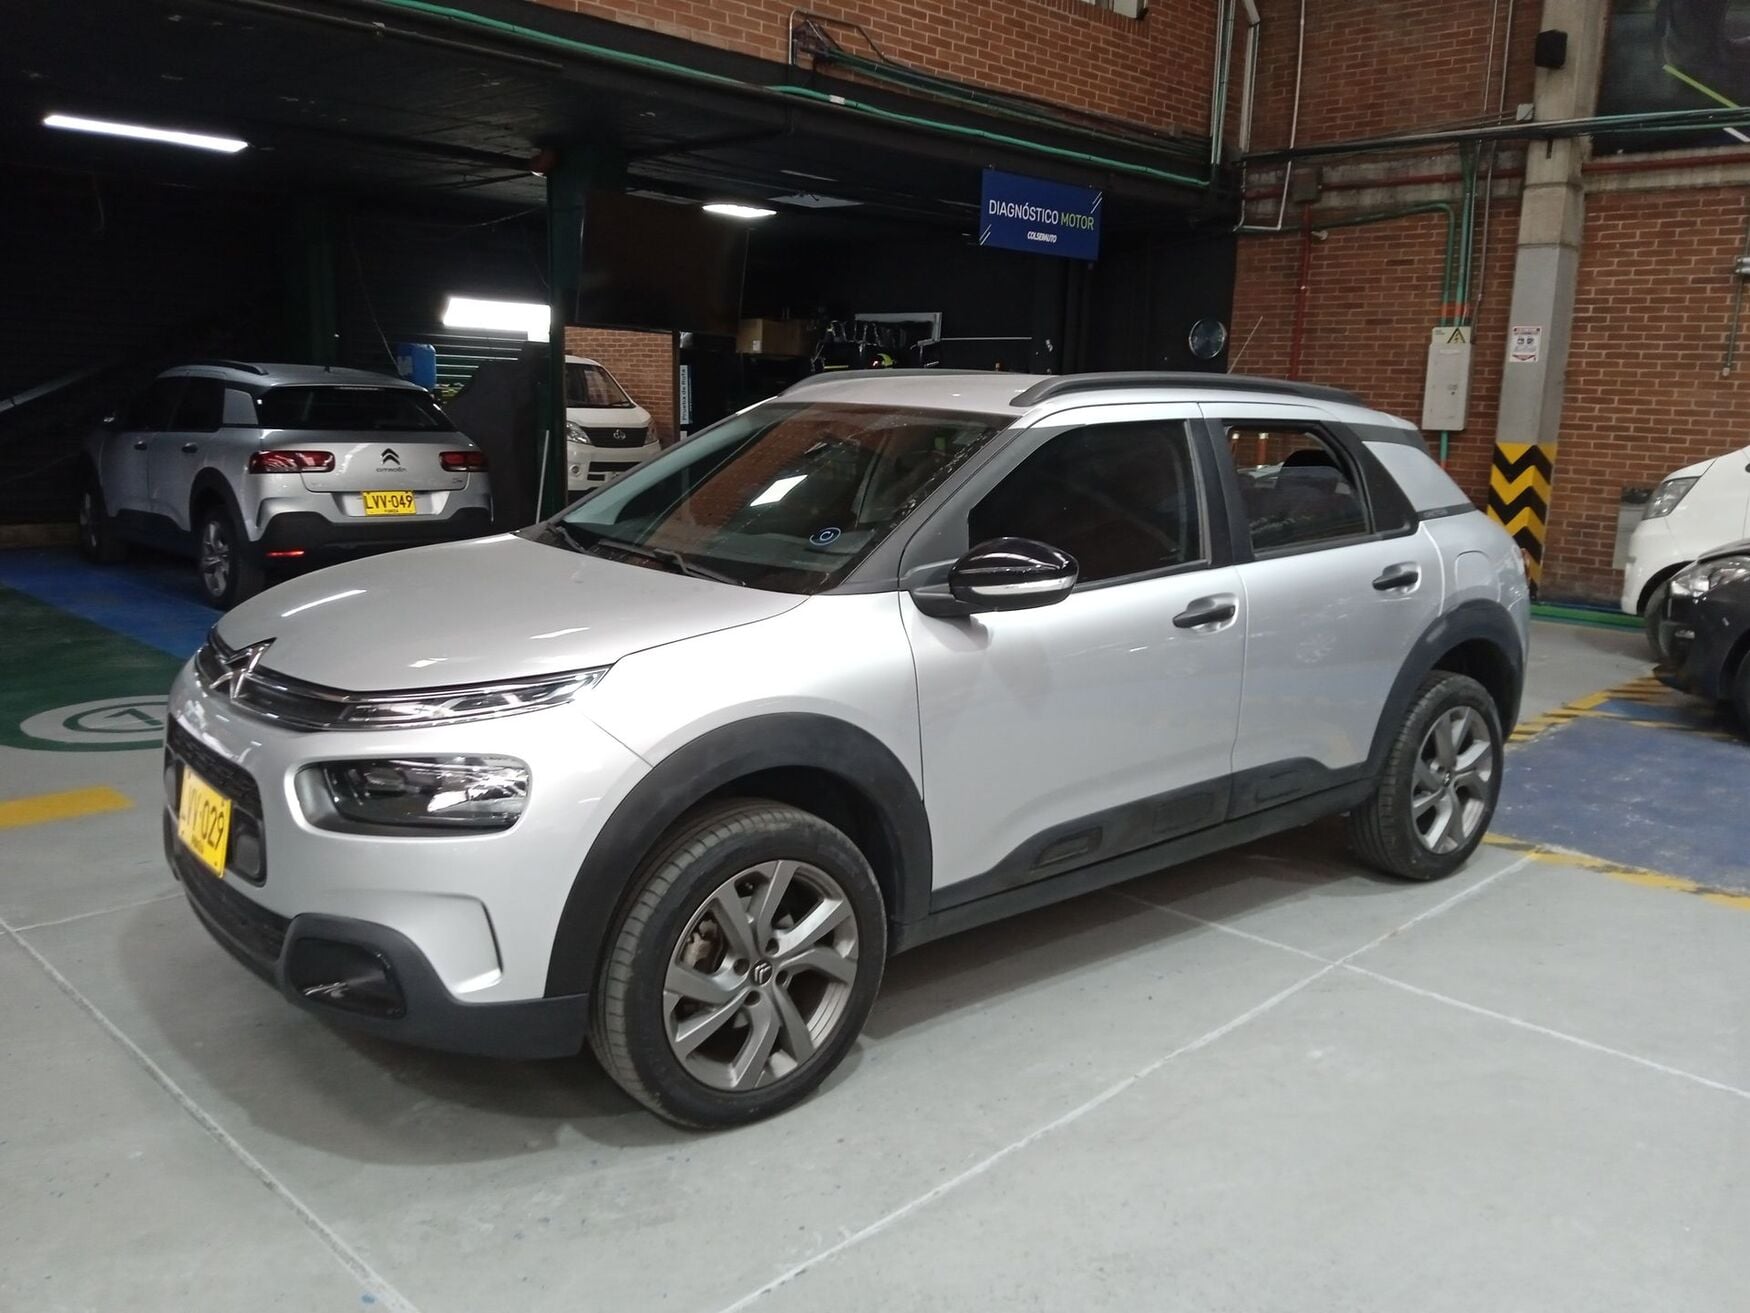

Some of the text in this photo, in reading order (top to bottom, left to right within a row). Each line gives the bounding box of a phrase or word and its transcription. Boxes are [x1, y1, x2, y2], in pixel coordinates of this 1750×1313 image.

[988, 199, 1095, 231] DIAGNÓSTICO MOTOR
[365, 495, 413, 510] LVV-049
